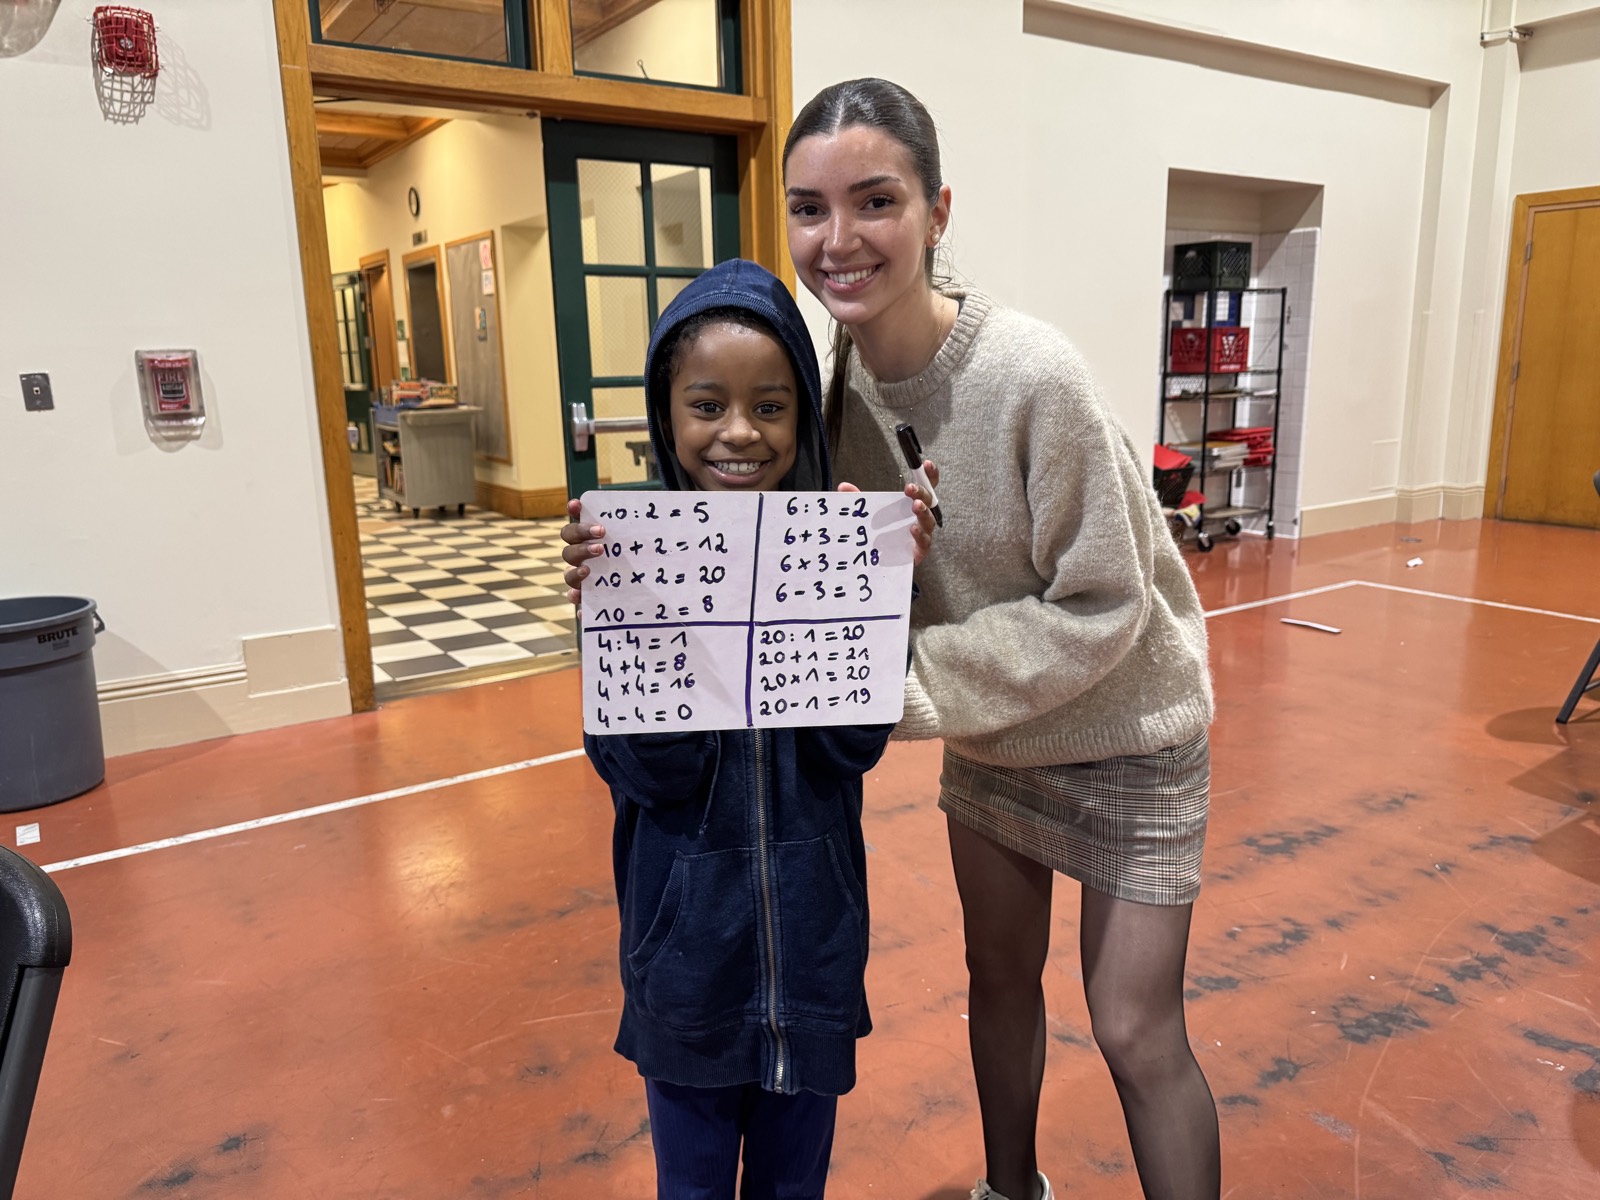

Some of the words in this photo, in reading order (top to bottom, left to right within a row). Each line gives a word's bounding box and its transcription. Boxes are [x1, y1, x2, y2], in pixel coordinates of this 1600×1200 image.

[645, 502, 660, 520] 2
[693, 501, 710, 524] 5
[786, 496, 798, 516] 6
[816, 497, 829, 516] 3
[851, 497, 869, 518] 2
[653, 537, 668, 555] 2
[698, 532, 728, 554] 12
[783, 527, 796, 546] 6
[817, 527, 831, 546] 3
[855, 525, 868, 547] 9
[780, 554, 792, 573] 6
[817, 552, 830, 573] 3
[852, 548, 880, 567] 18
[594, 571, 622, 588] 10
[654, 567, 669, 585] 2
[698, 565, 726, 585] 20
[775, 582, 788, 603] 6
[813, 580, 826, 601] 3
[856, 573, 873, 603] 3
[594, 607, 625, 623] 10
[654, 603, 669, 620] 2
[701, 594, 714, 614] 8
[37, 626, 79, 644] BRUTE
[597, 632, 613, 653] 4
[625, 630, 641, 650] 4
[670, 630, 688, 648] 1
[760, 629, 786, 646] 20
[804, 628, 816, 643] 1
[842, 623, 865, 641] 20
[599, 655, 613, 678] 4
[634, 654, 646, 674] 4
[673, 652, 687, 672] 8
[758, 651, 786, 666] 20
[807, 651, 819, 662] 1
[845, 646, 870, 661] 21
[597, 679, 610, 702] 4
[635, 674, 646, 697] 4
[669, 672, 696, 690] 16
[760, 672, 787, 692] 20
[805, 667, 819, 683] 1
[846, 665, 871, 681] 20
[759, 698, 788, 716] 20
[805, 695, 819, 710] 1
[845, 687, 872, 705] 19
[597, 707, 610, 729] 4
[634, 706, 646, 724] 4
[677, 703, 694, 721] 0
